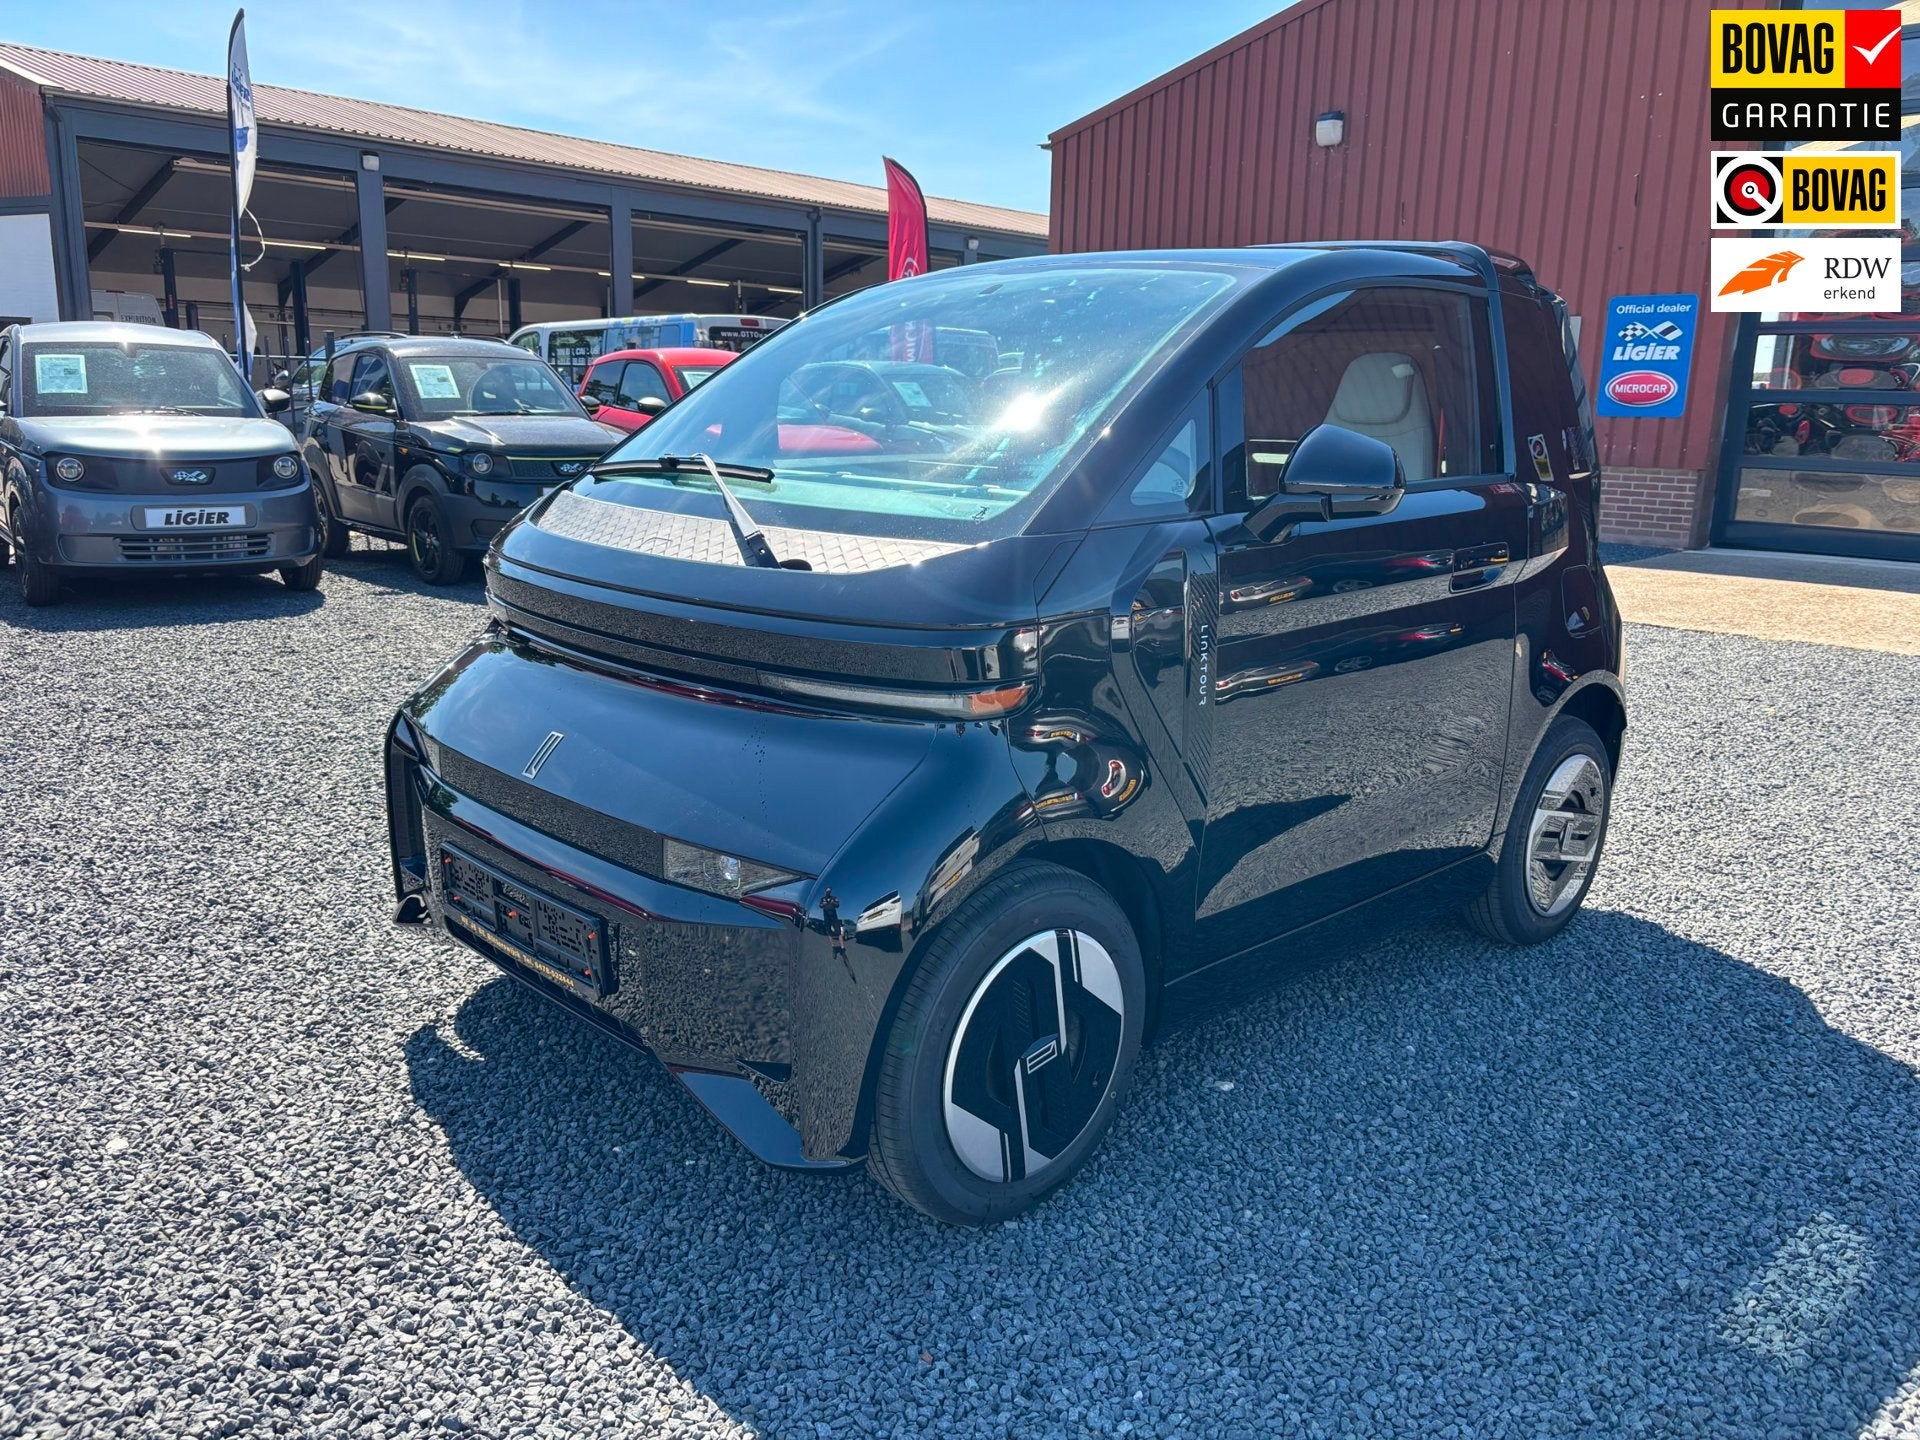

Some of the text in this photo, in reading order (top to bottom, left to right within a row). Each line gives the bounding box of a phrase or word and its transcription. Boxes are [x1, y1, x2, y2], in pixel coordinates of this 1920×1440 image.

[1616, 303, 1692, 314] Official dealer
[1612, 342, 1681, 361] LIGIER
[1614, 384, 1668, 394] MICROCAR
[164, 509, 230, 526] LIGIER
